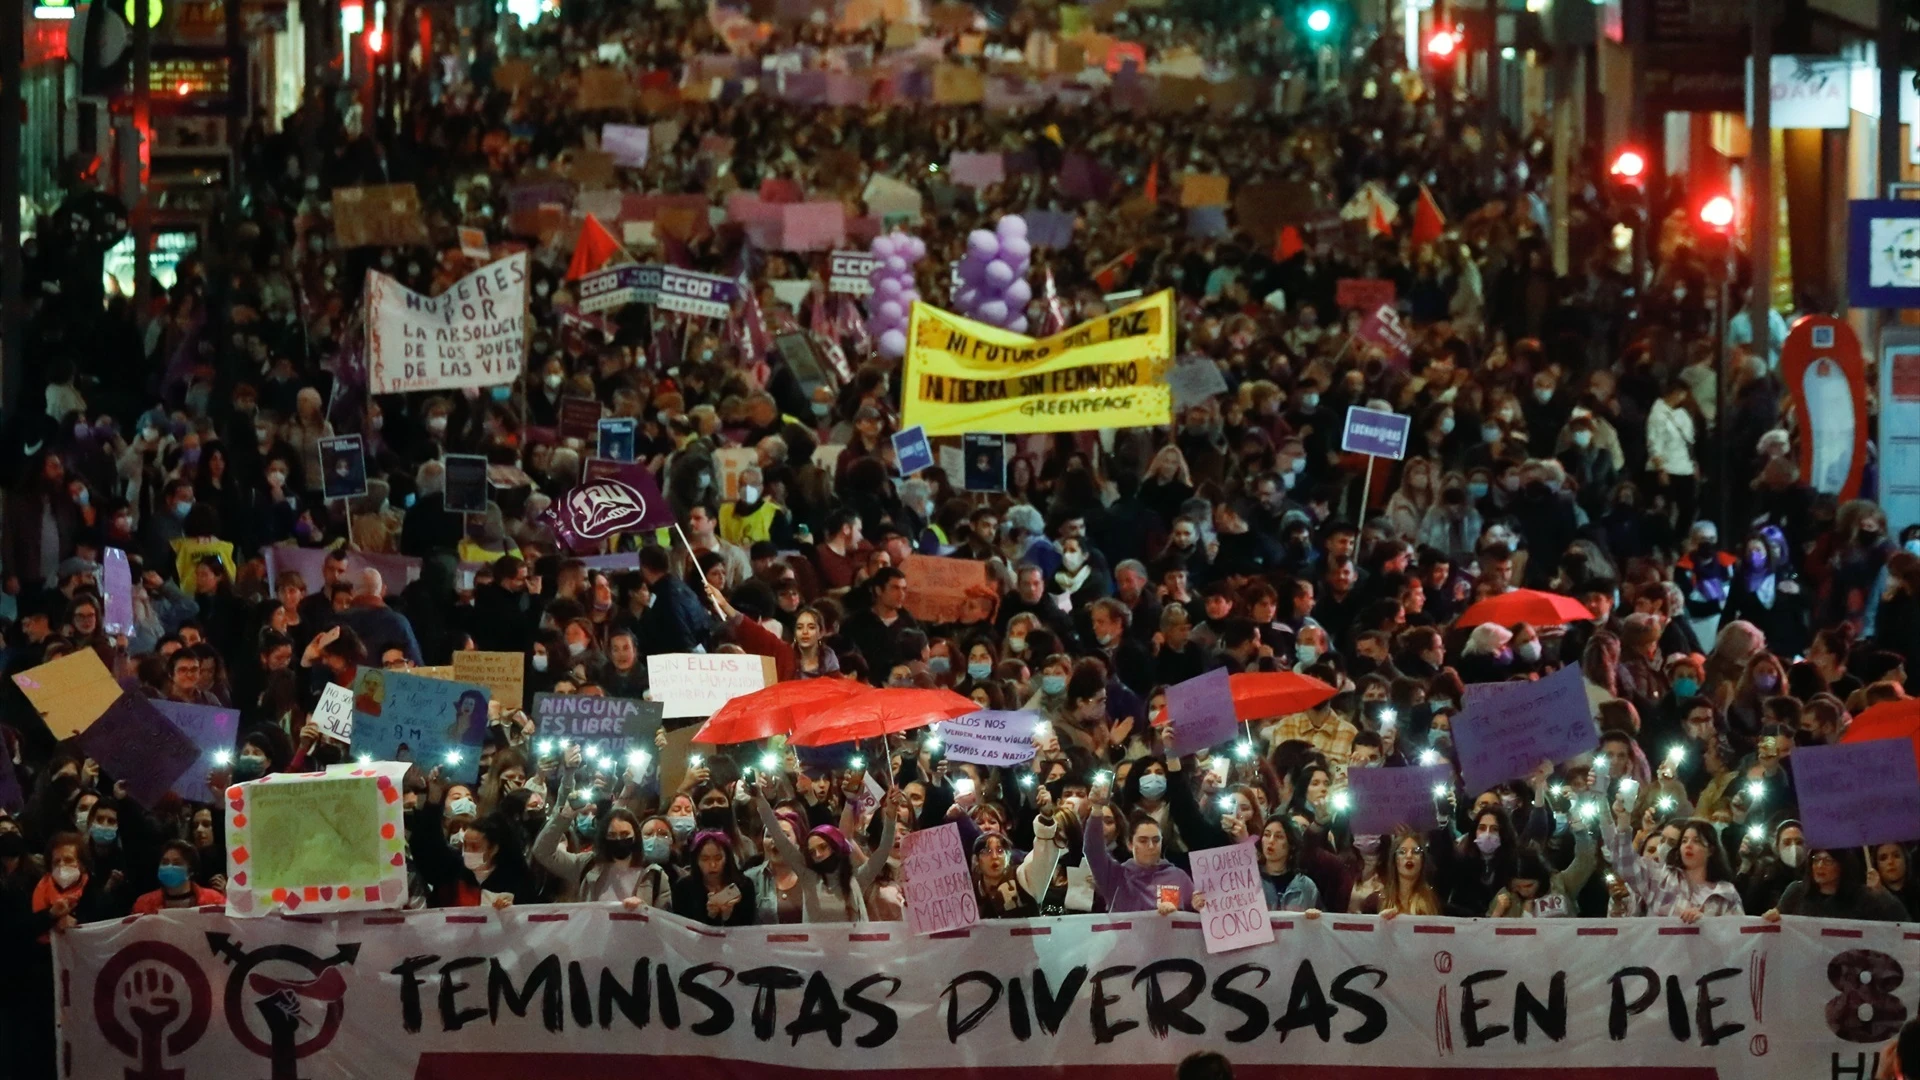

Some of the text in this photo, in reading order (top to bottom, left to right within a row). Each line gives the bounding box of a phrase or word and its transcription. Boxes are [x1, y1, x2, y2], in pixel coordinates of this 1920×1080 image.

[580, 272, 619, 297] CCOO
[662, 275, 713, 298] CCOO
[445, 299, 498, 325] POR
[404, 323, 427, 341] LA
[947, 330, 967, 351] NI
[972, 339, 1050, 363] FUTURO
[1108, 311, 1149, 340] PAZ
[404, 342, 426, 358] DE
[438, 344, 466, 360] LOS
[404, 362, 427, 379] DE
[440, 361, 472, 377] LAS
[926, 362, 1138, 403] NI TIERRA SIN FEMINISMO
[1019, 394, 1136, 417] GREENPEACE
[687, 657, 739, 673] ELLAS
[321, 699, 342, 715] NO
[539, 697, 640, 717] NINGUNA
[394, 724, 403, 740] 8
[409, 728, 422, 741] M
[540, 716, 626, 735] ES LIBRE
[985, 719, 1006, 730] NOS
[953, 743, 979, 757] SOMOS
[982, 749, 999, 759] LAS
[944, 847, 963, 867] NO
[1197, 848, 1252, 875] SI QUIERES
[907, 880, 933, 903] NOS
[1200, 868, 1255, 894] LA CENA
[914, 893, 976, 931] MATADO
[1206, 898, 1219, 914] ME
[1220, 893, 1248, 911] COMES
[1209, 908, 1263, 940] COÑO
[390, 948, 1769, 1058] FEMINISTAS DIVERSAS ¡EN PIE!
[1825, 948, 1908, 1044] 8
